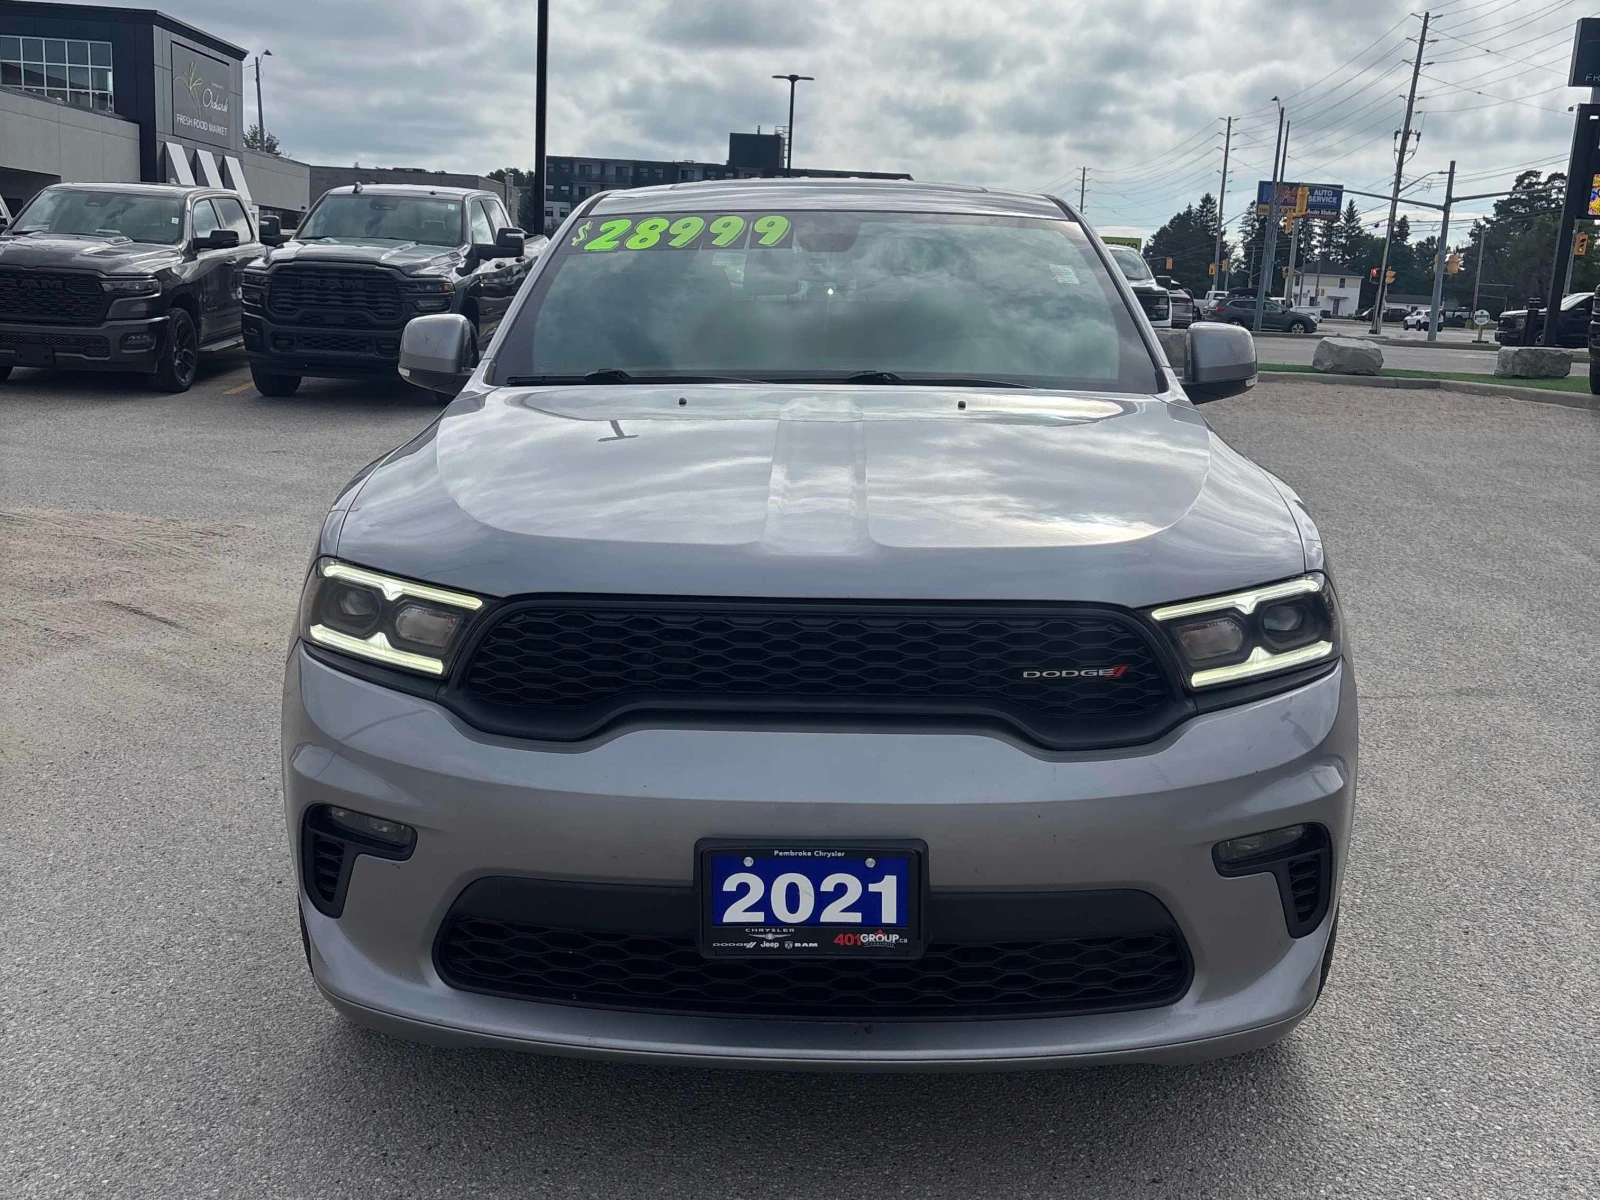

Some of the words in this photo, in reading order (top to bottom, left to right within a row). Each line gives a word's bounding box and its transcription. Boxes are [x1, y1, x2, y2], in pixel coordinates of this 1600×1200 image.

[176, 113, 193, 126] FRESH
[193, 118, 208, 131] FOOD
[208, 123, 228, 136] MARKET
[1023, 668, 1115, 678] DODGE
[813, 850, 845, 858] Chrysler
[722, 872, 897, 924] 2021
[760, 941, 780, 949] Jeep
